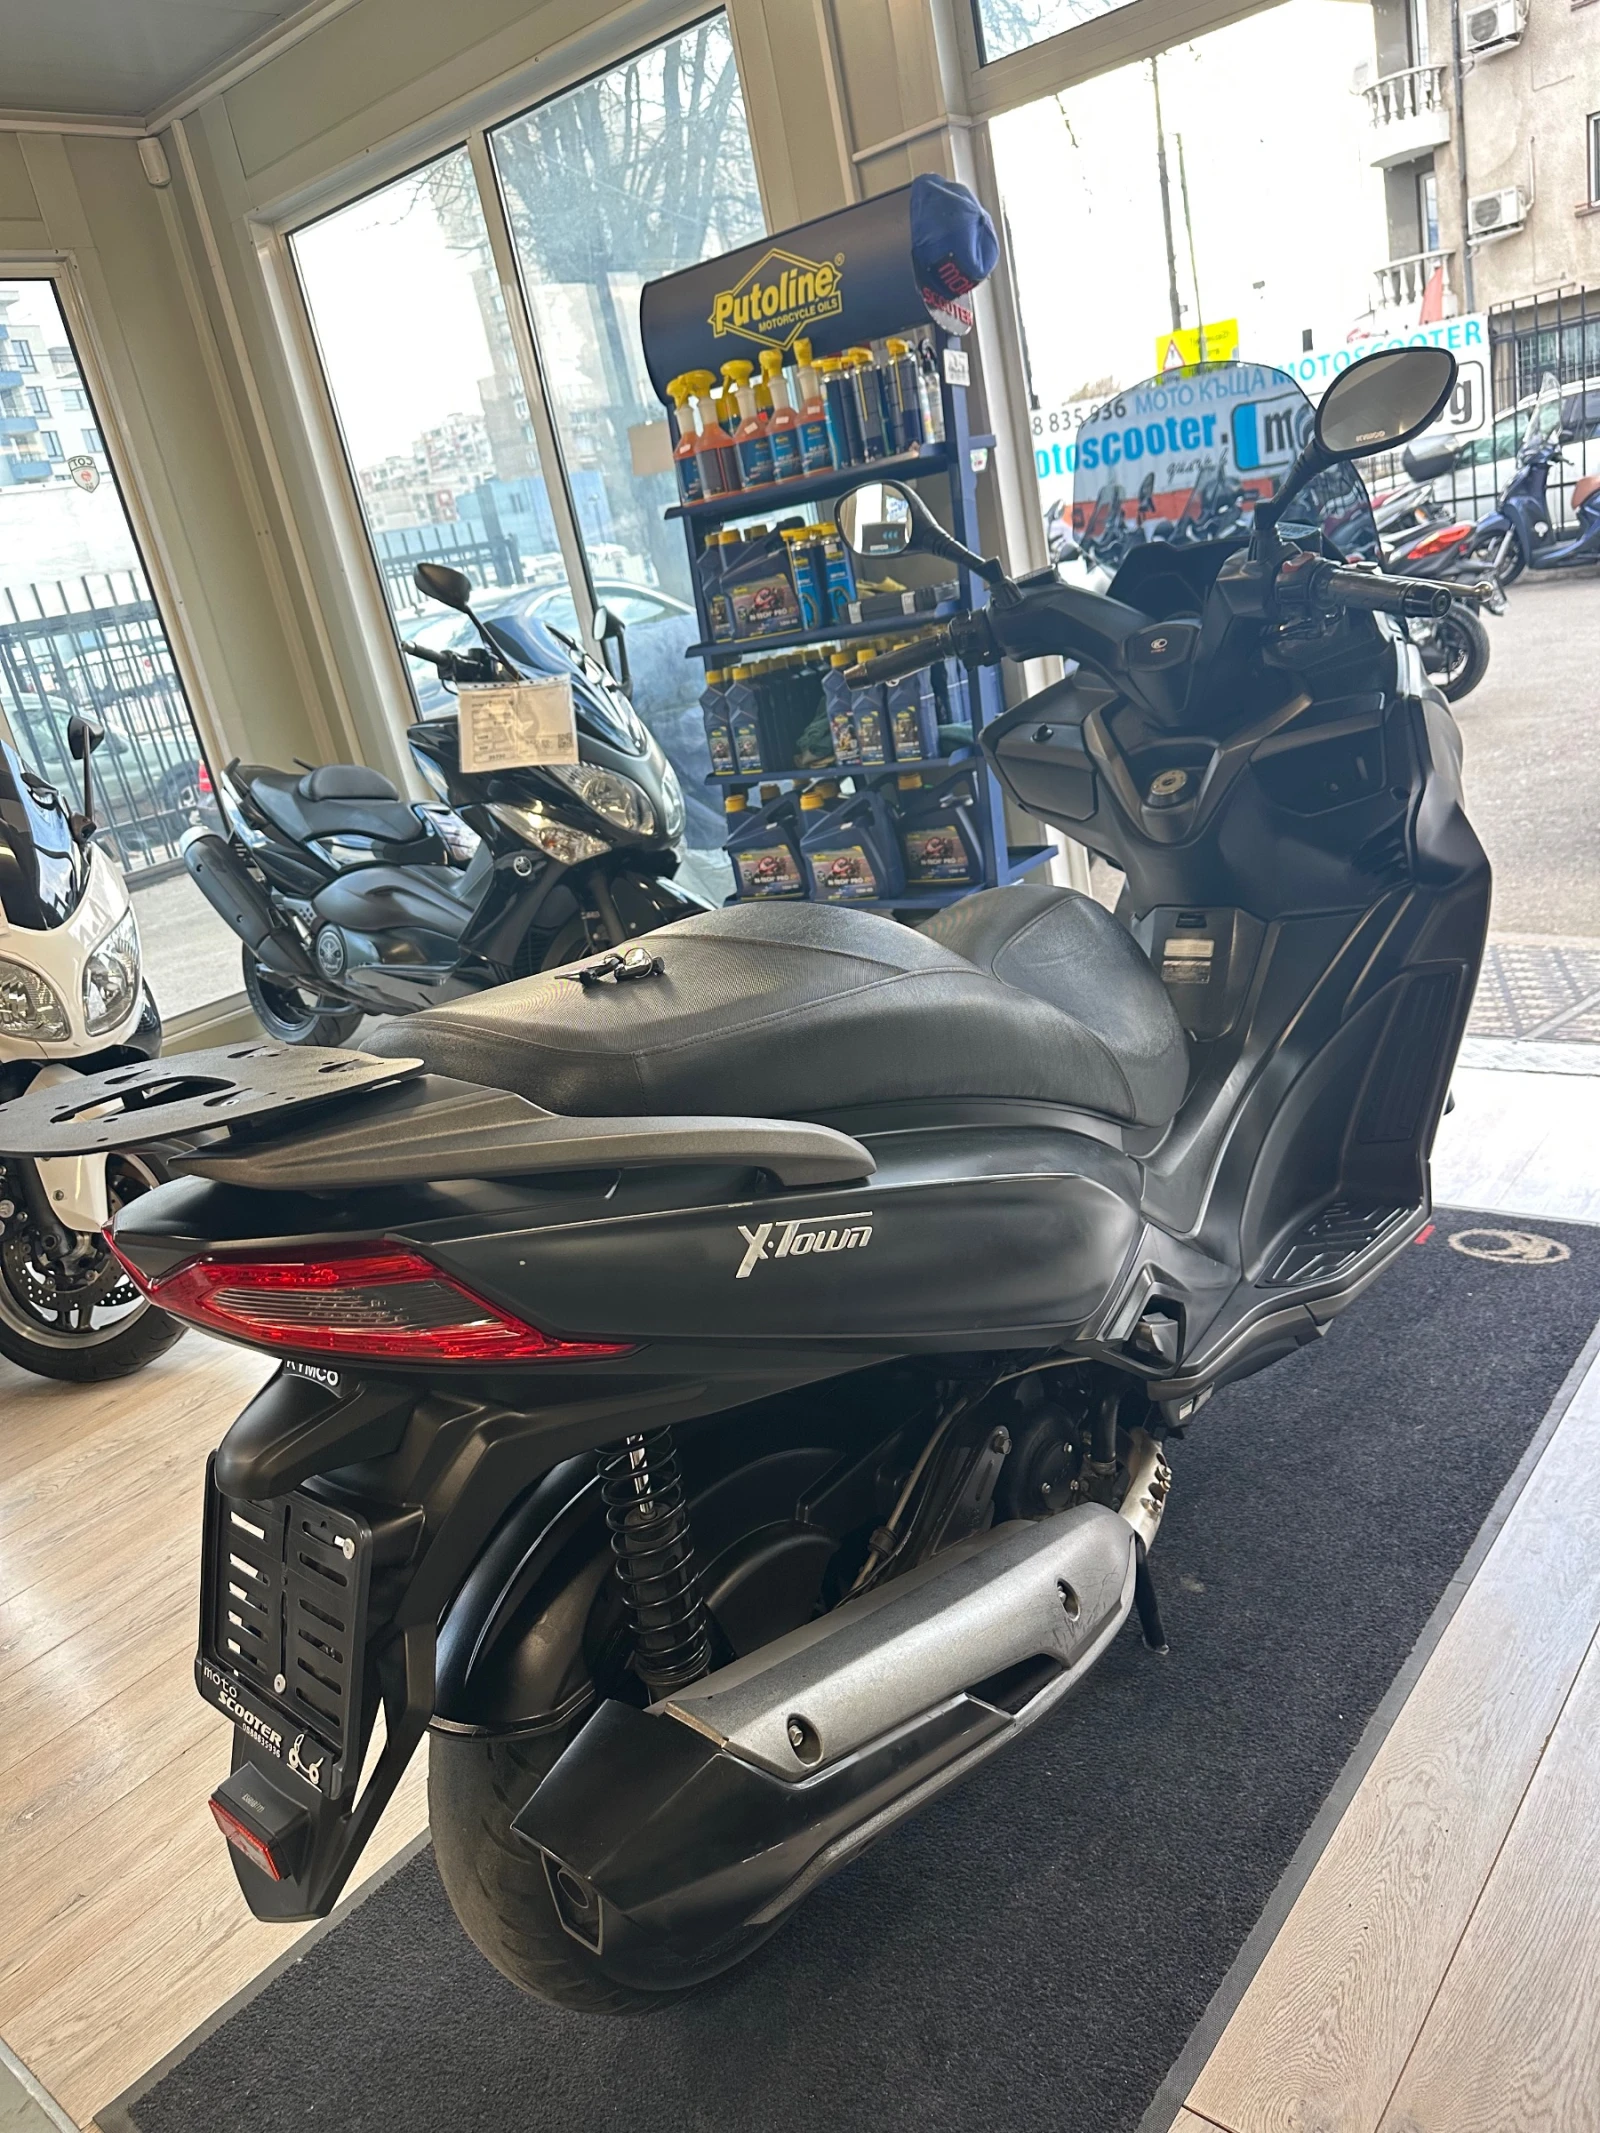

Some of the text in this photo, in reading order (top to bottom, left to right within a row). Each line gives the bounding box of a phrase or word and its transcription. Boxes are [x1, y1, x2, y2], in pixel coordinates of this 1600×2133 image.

[716, 266, 834, 333] Putoline
[758, 298, 838, 333] MOTORCYCLE OILS
[1199, 367, 1266, 402] КЪЩА
[1090, 398, 1127, 423] 936
[1035, 411, 1229, 478] otoscooter.
[218, 1690, 282, 1748] SCOOTER
